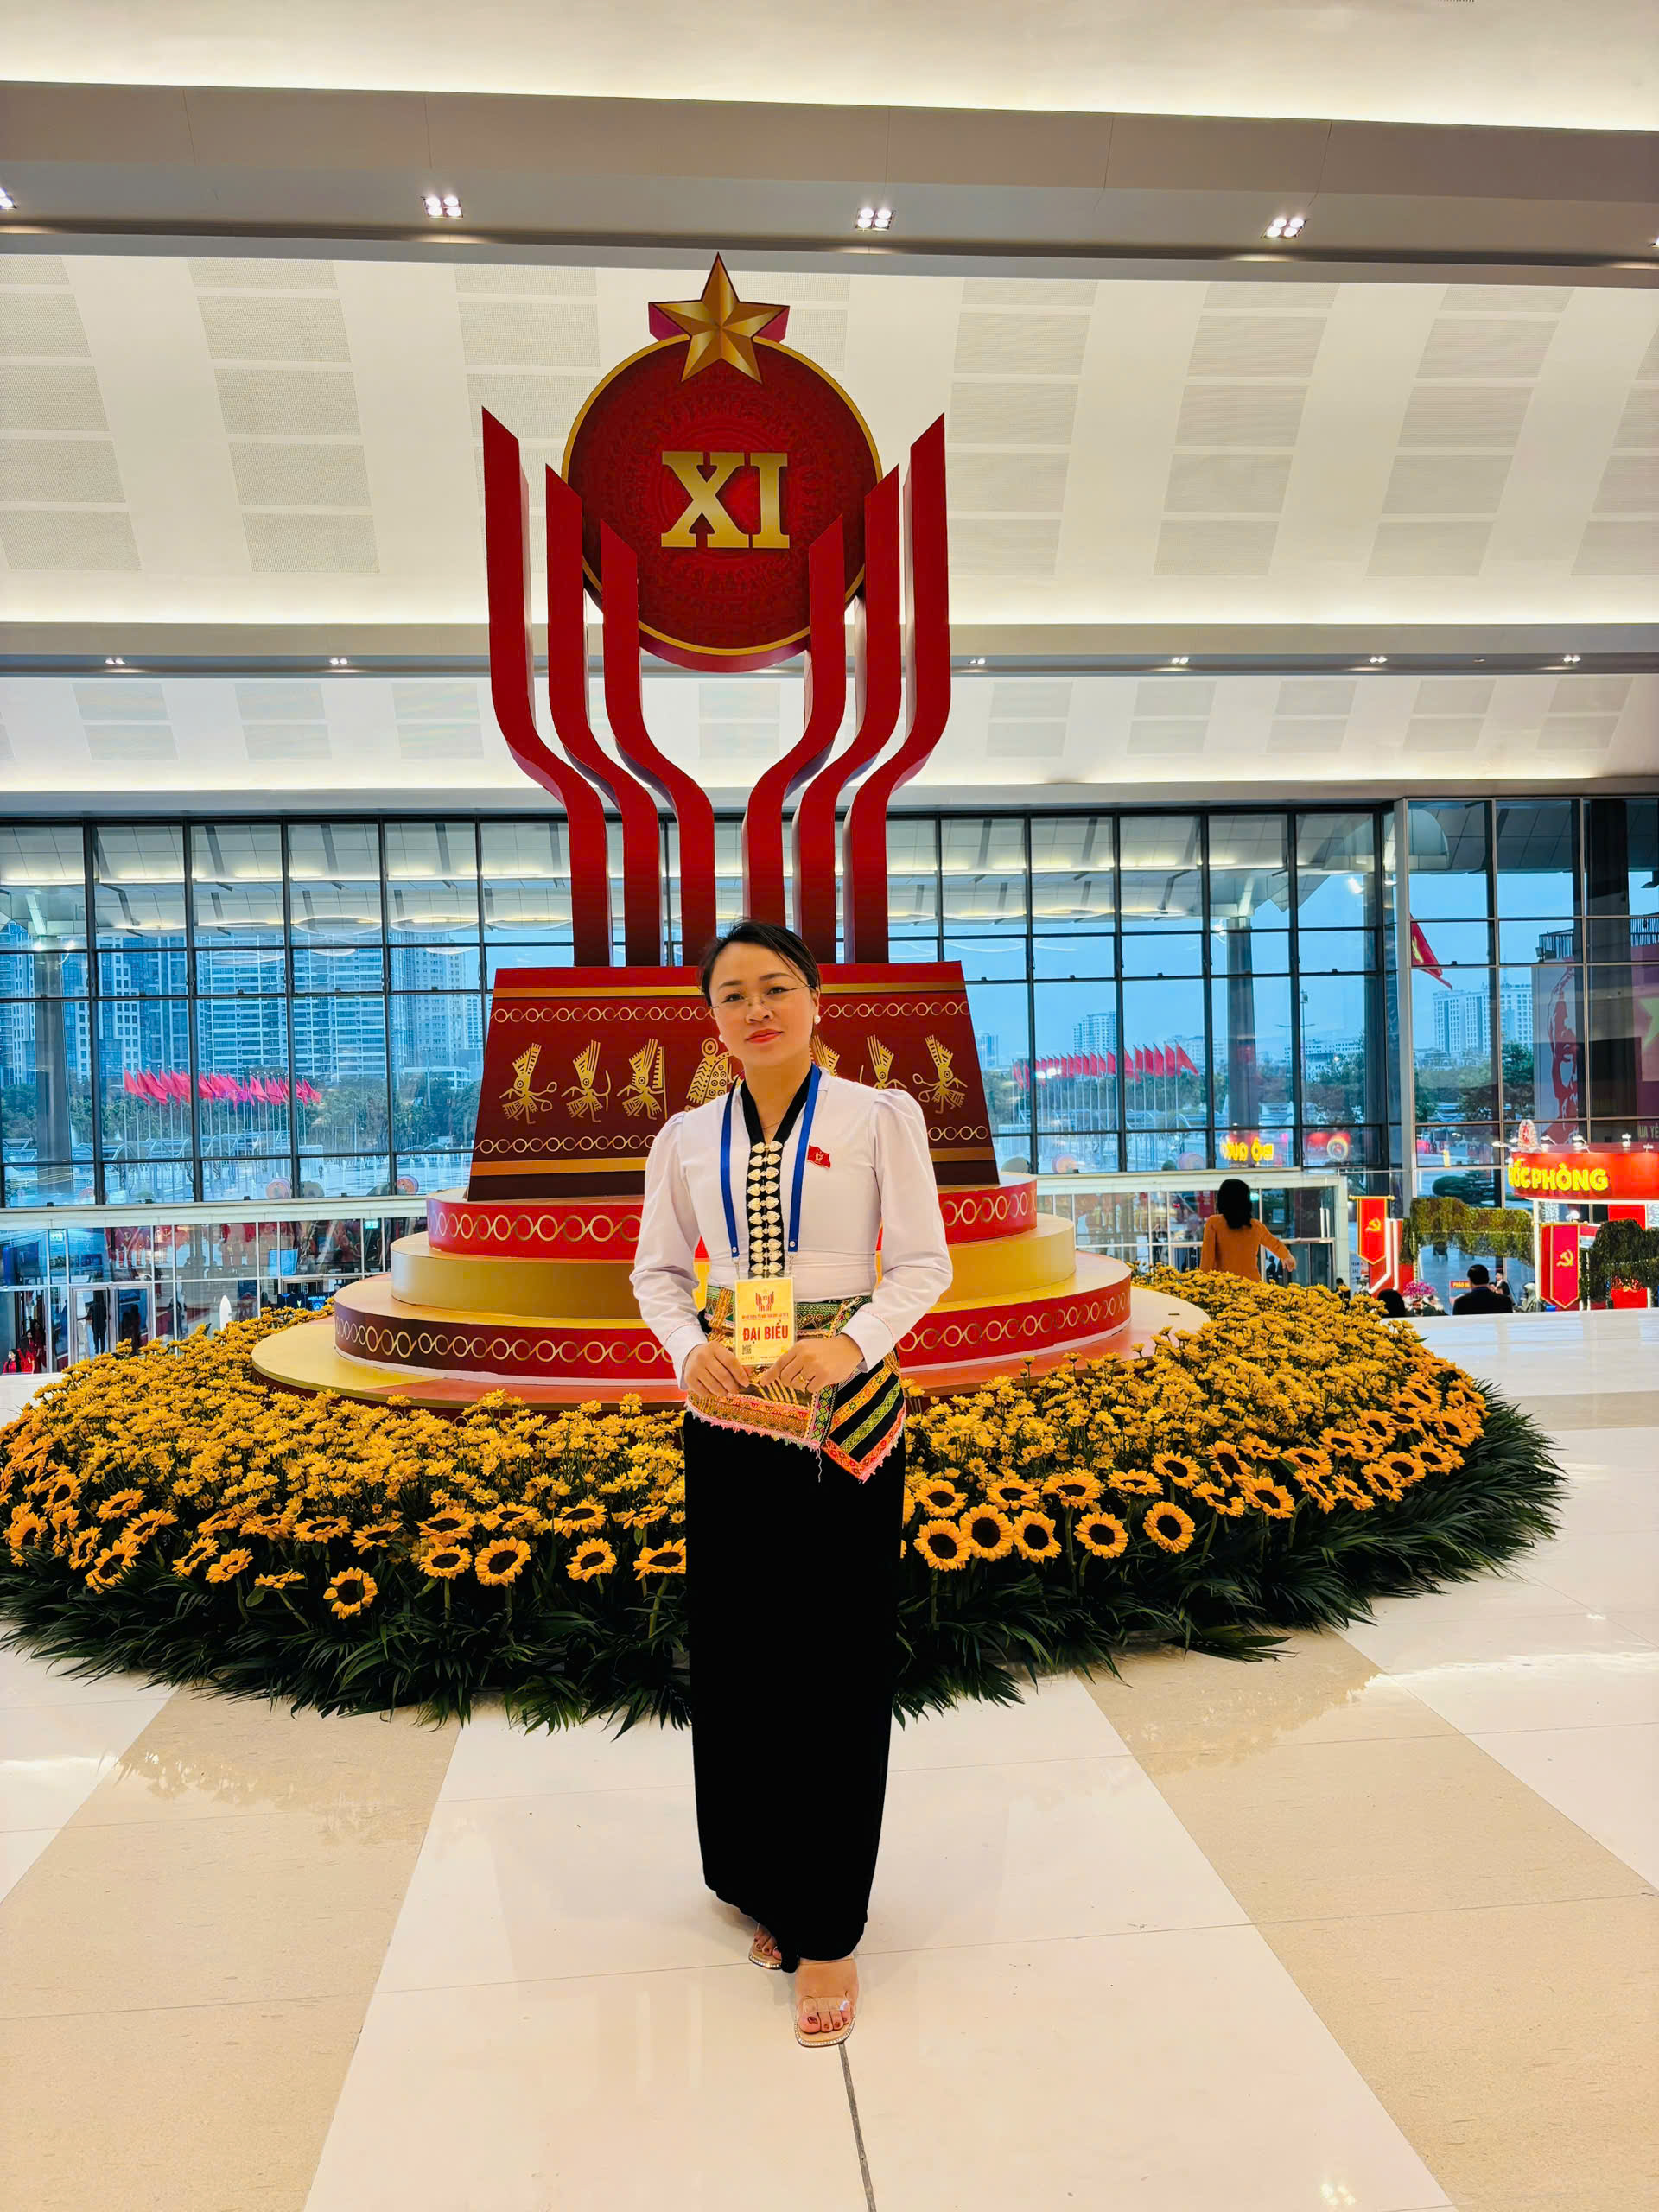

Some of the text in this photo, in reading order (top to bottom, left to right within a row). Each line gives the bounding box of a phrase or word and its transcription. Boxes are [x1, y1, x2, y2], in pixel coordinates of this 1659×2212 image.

[661, 451, 790, 549] XI
[1531, 1161, 1609, 1192] PHÒNG
[743, 1319, 789, 1344] ĐẠI BIỂU
